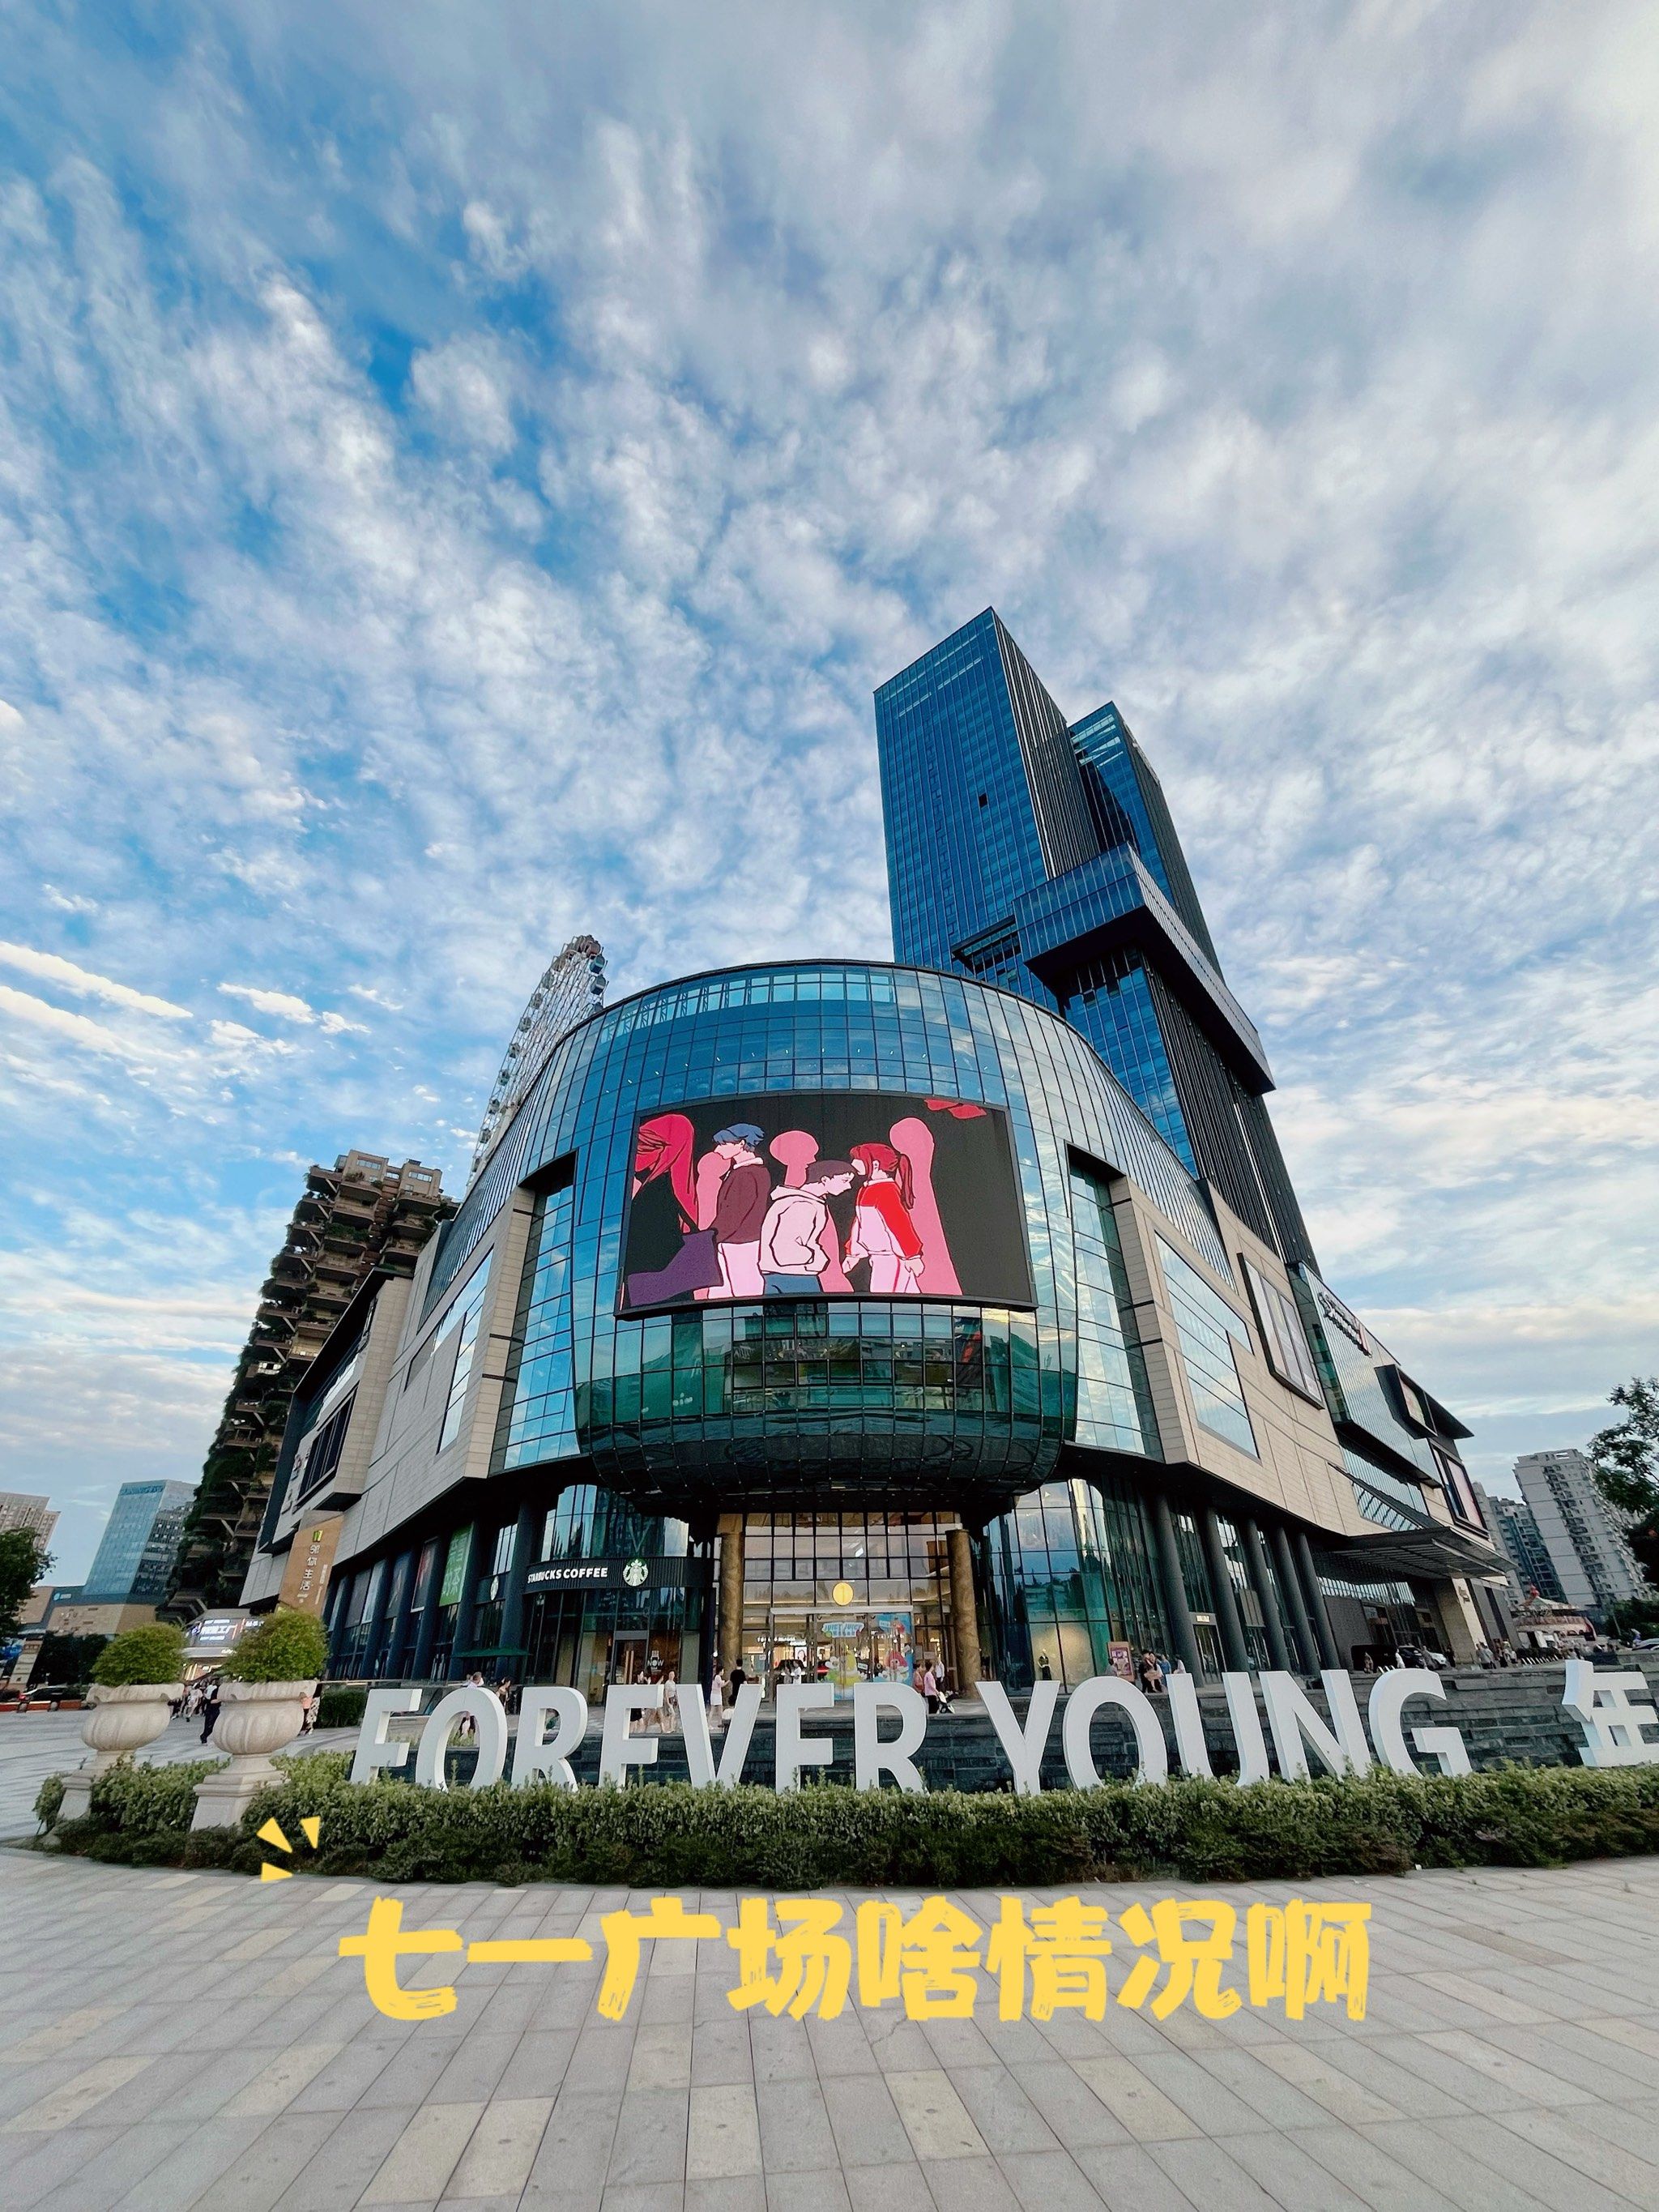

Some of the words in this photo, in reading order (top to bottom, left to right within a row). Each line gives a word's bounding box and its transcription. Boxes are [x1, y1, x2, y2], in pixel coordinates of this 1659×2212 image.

[527, 1569, 562, 1584] STARBUCKS
[563, 1567, 608, 1579] COFFEE
[350, 1682, 928, 1794] FOREVER
[975, 1668, 1472, 1795] YOUNG
